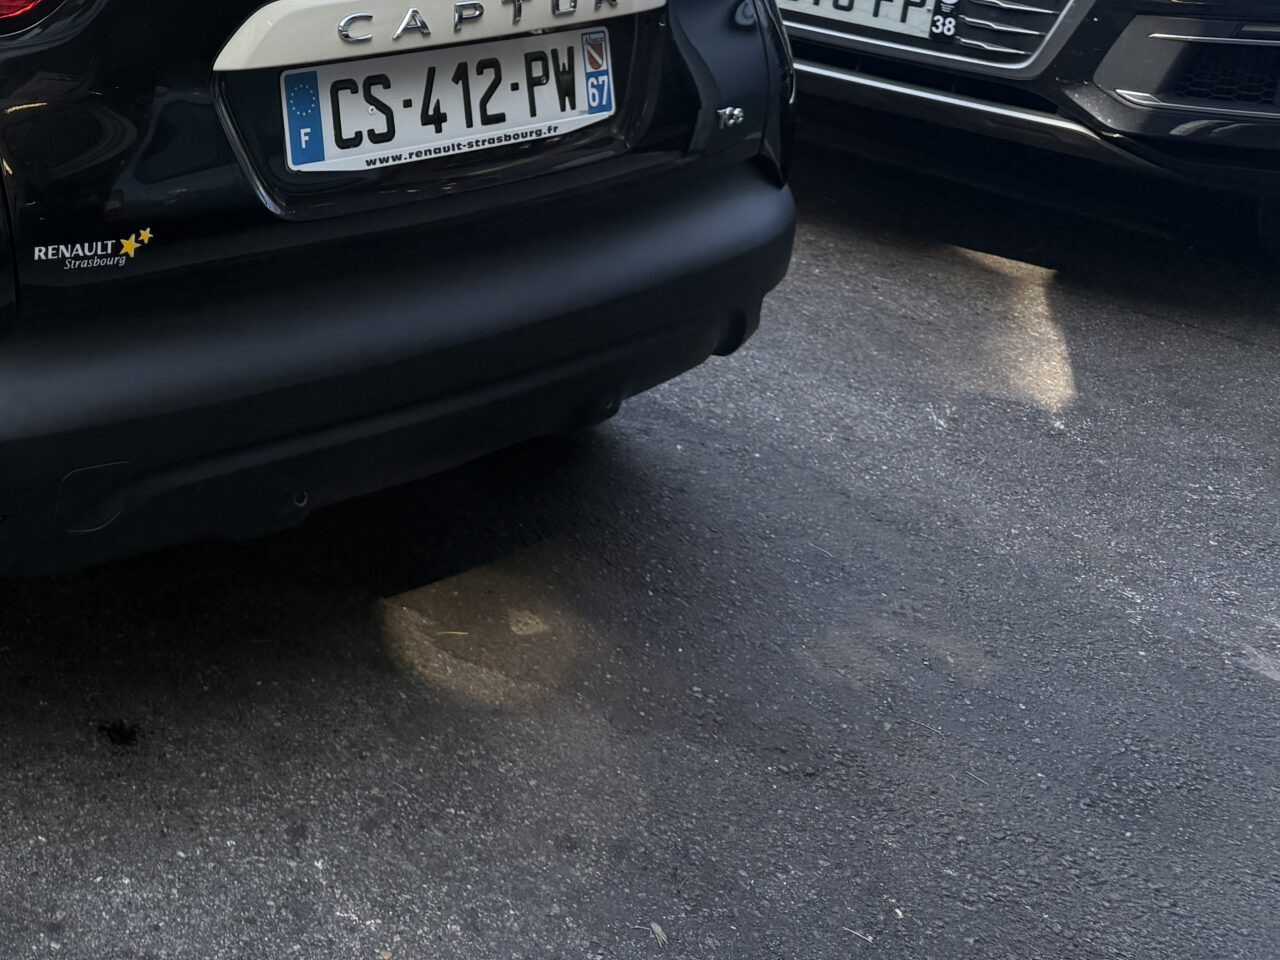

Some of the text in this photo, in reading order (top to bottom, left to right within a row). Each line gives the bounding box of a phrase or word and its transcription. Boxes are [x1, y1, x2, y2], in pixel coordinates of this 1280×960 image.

[932, 15, 956, 36] 38
[300, 45, 608, 150] F CS-412-PW 67
[366, 125, 559, 167] www.renault-strasbourg.fr
[34, 240, 116, 260] RENAULT
[64, 254, 126, 270] Strasbourg
